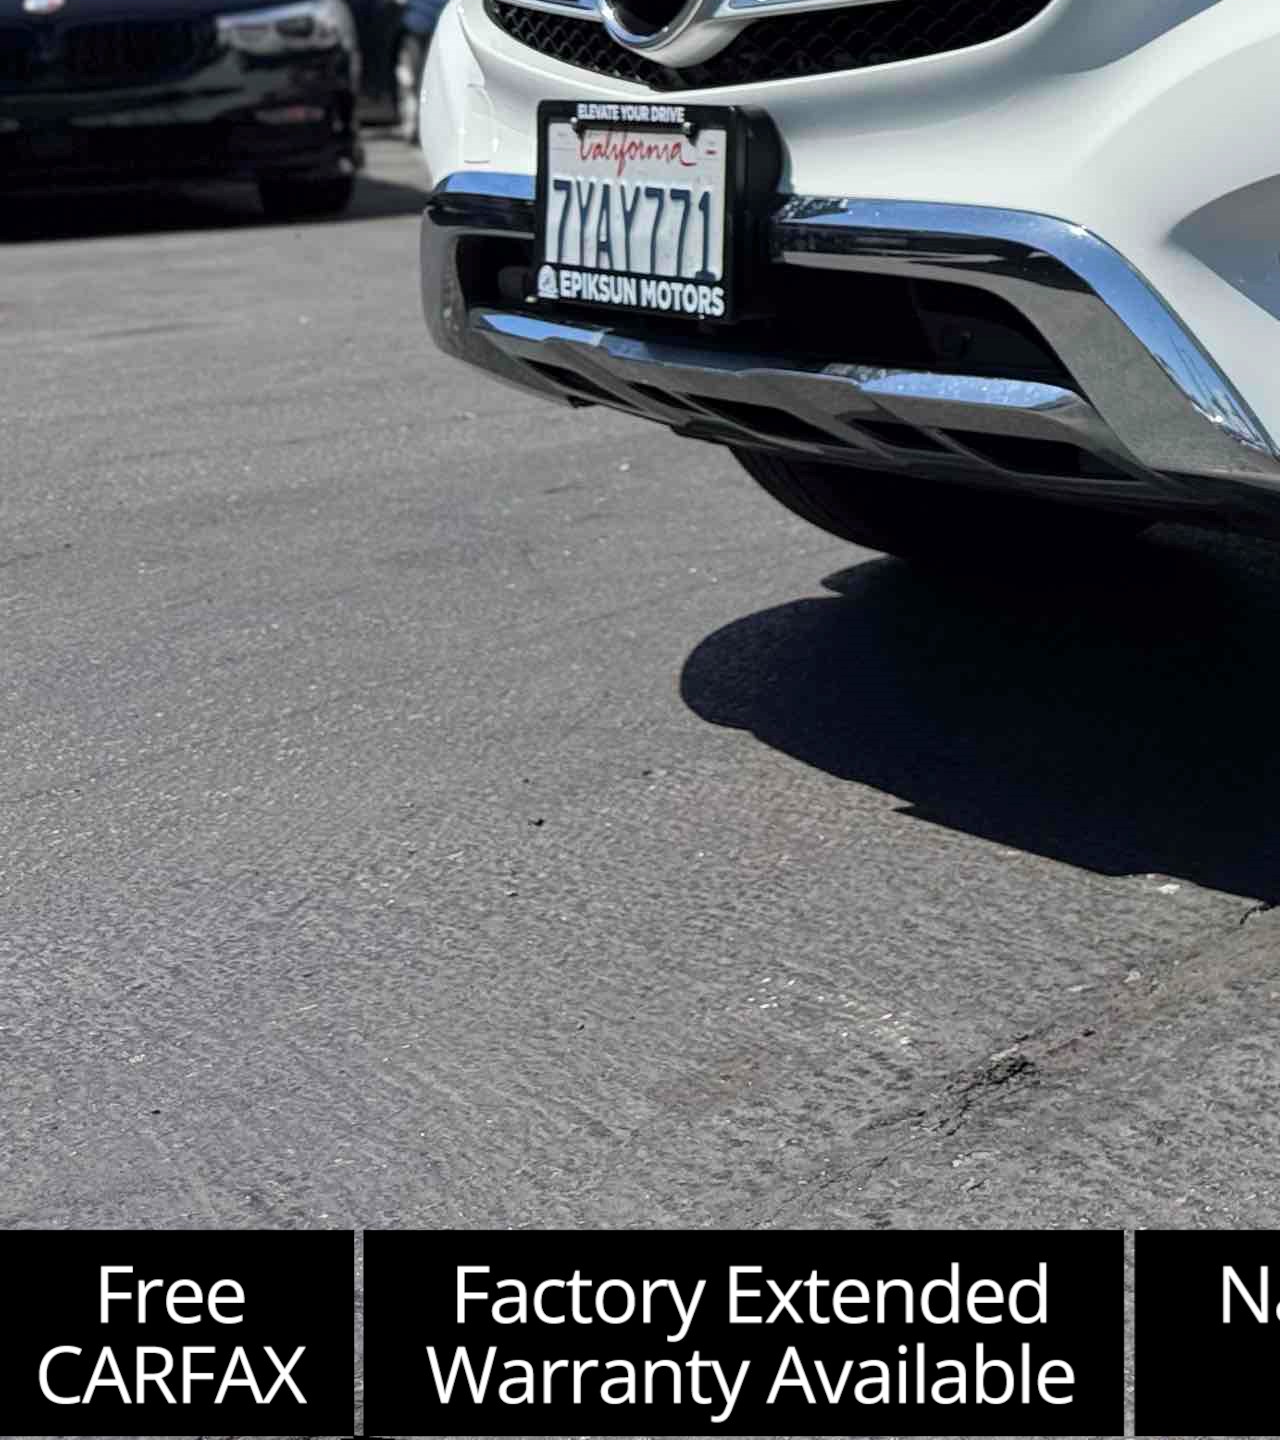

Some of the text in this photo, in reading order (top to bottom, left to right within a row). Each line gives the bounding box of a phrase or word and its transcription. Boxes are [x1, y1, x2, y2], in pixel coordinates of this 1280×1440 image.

[576, 103, 685, 123] ELEVATE YOUR DRIVE
[579, 129, 697, 177] California
[553, 179, 716, 282] 7YAY771
[559, 269, 725, 317] EPIKSUN MOTORS
